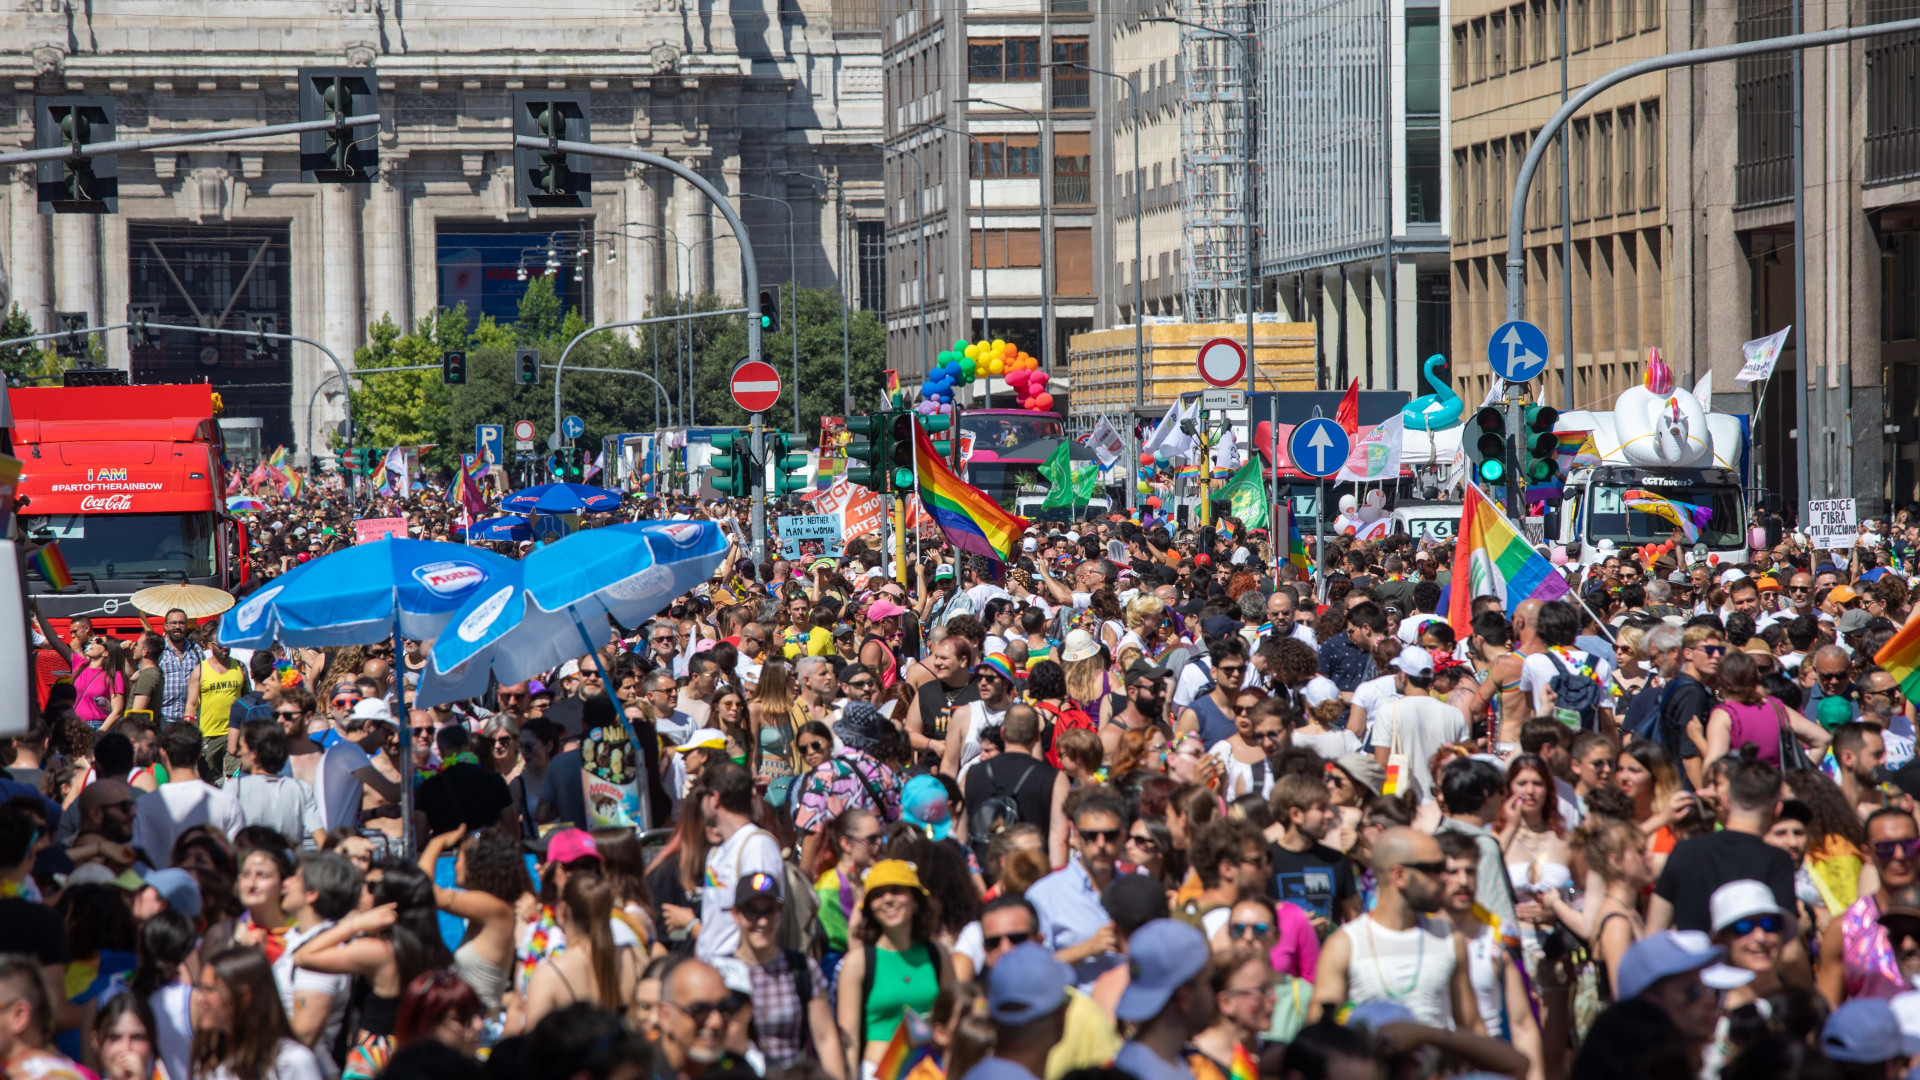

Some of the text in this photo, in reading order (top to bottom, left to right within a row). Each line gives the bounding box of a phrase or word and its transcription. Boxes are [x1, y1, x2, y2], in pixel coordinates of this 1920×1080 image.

[482, 427, 497, 446] P
[466, 455, 475, 467] P
[88, 468, 127, 481] I AM
[51, 482, 163, 492] #PARTOFTHERAINBOW
[80, 494, 134, 511] Coca-Cola
[1810, 499, 1851, 512] COME DICE
[791, 516, 830, 526] IT'S NEITHER
[1820, 511, 1847, 524] FIBRA
[785, 526, 803, 537] MAN
[812, 526, 835, 535] WOMAN
[1416, 522, 1448, 536] 16
[1811, 525, 1857, 536] MI PIACCIONO
[429, 570, 480, 587] Motta
[210, 680, 239, 690] HAWAII
